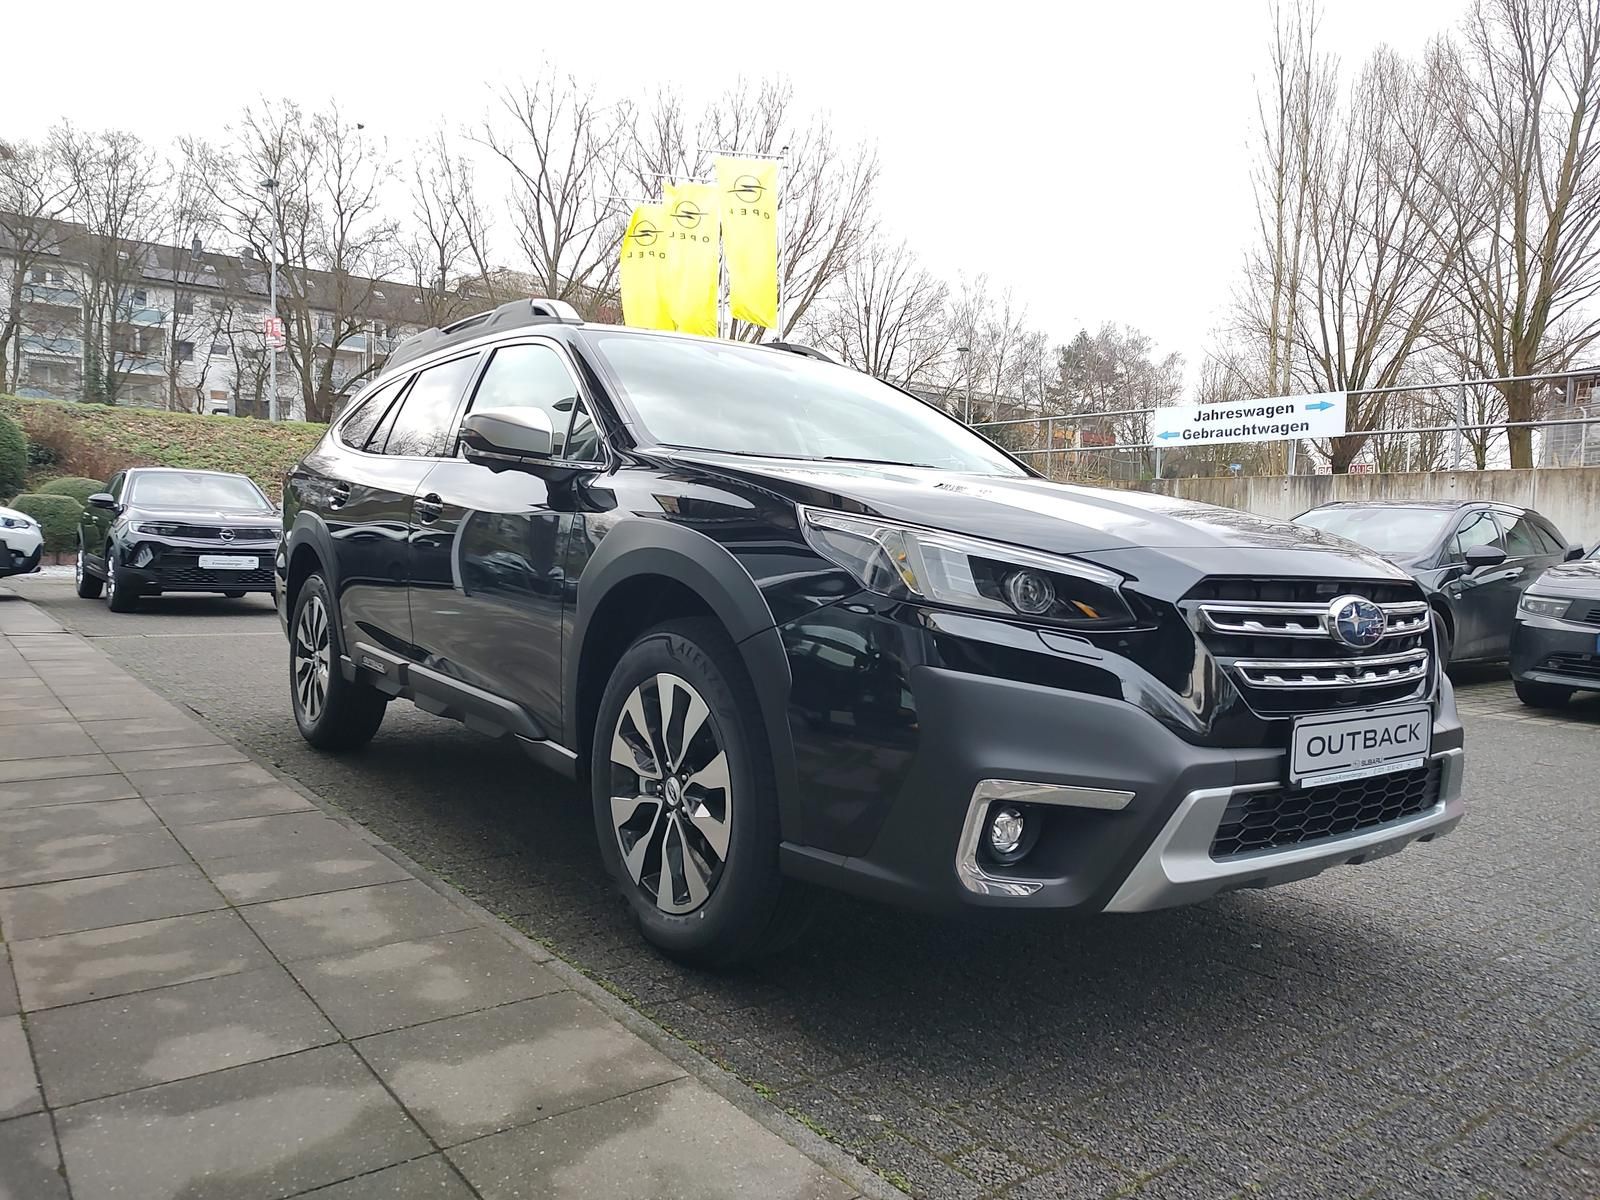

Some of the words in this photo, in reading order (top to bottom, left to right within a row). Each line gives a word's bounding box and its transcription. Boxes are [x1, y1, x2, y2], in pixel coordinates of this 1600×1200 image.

[1193, 402, 1295, 423] Jahreswagen
[1182, 420, 1310, 441] Gebrauchtwagen
[1306, 722, 1421, 758] OUTBACK
[1360, 757, 1384, 767] SUBARU
